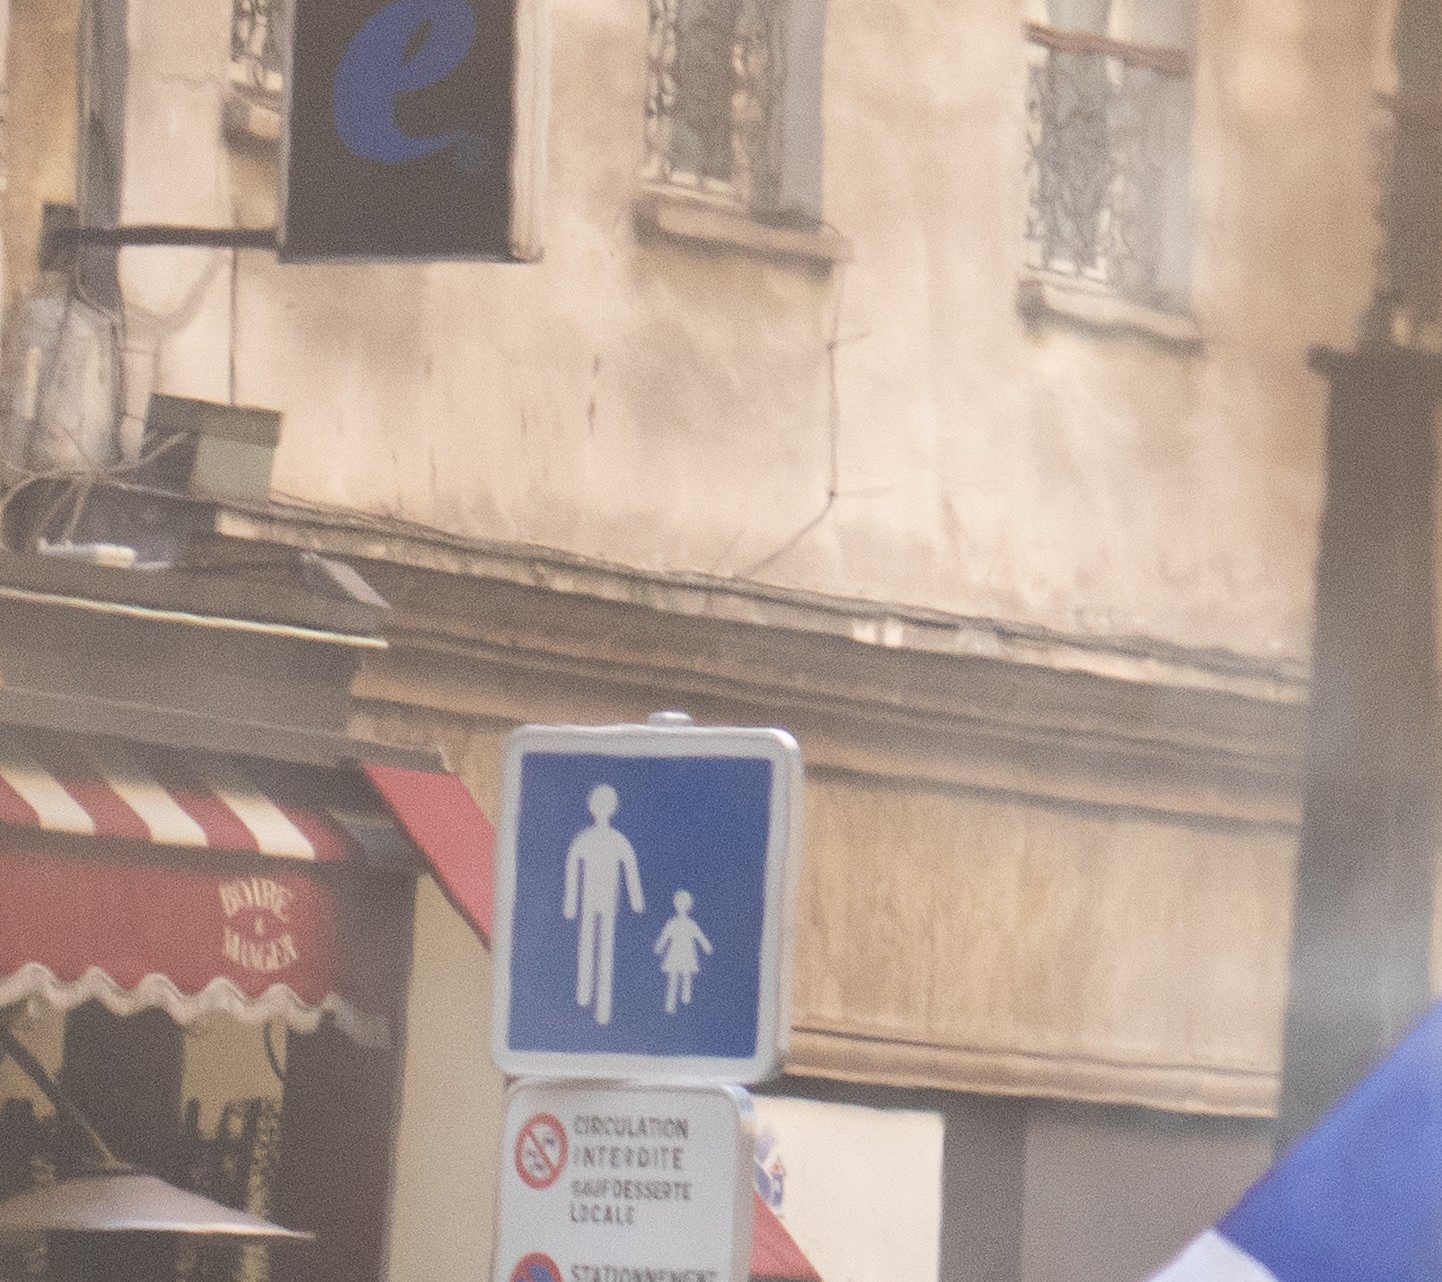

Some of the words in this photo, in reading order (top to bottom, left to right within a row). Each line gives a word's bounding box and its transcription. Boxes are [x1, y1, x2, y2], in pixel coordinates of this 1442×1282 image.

[572, 1114, 690, 1139] CIRCULATION
[572, 1145, 684, 1170] INTERDITE
[571, 1178, 610, 1198] SAUF
[612, 1179, 692, 1201] DESSERTE
[569, 1203, 636, 1225] LOCALE
